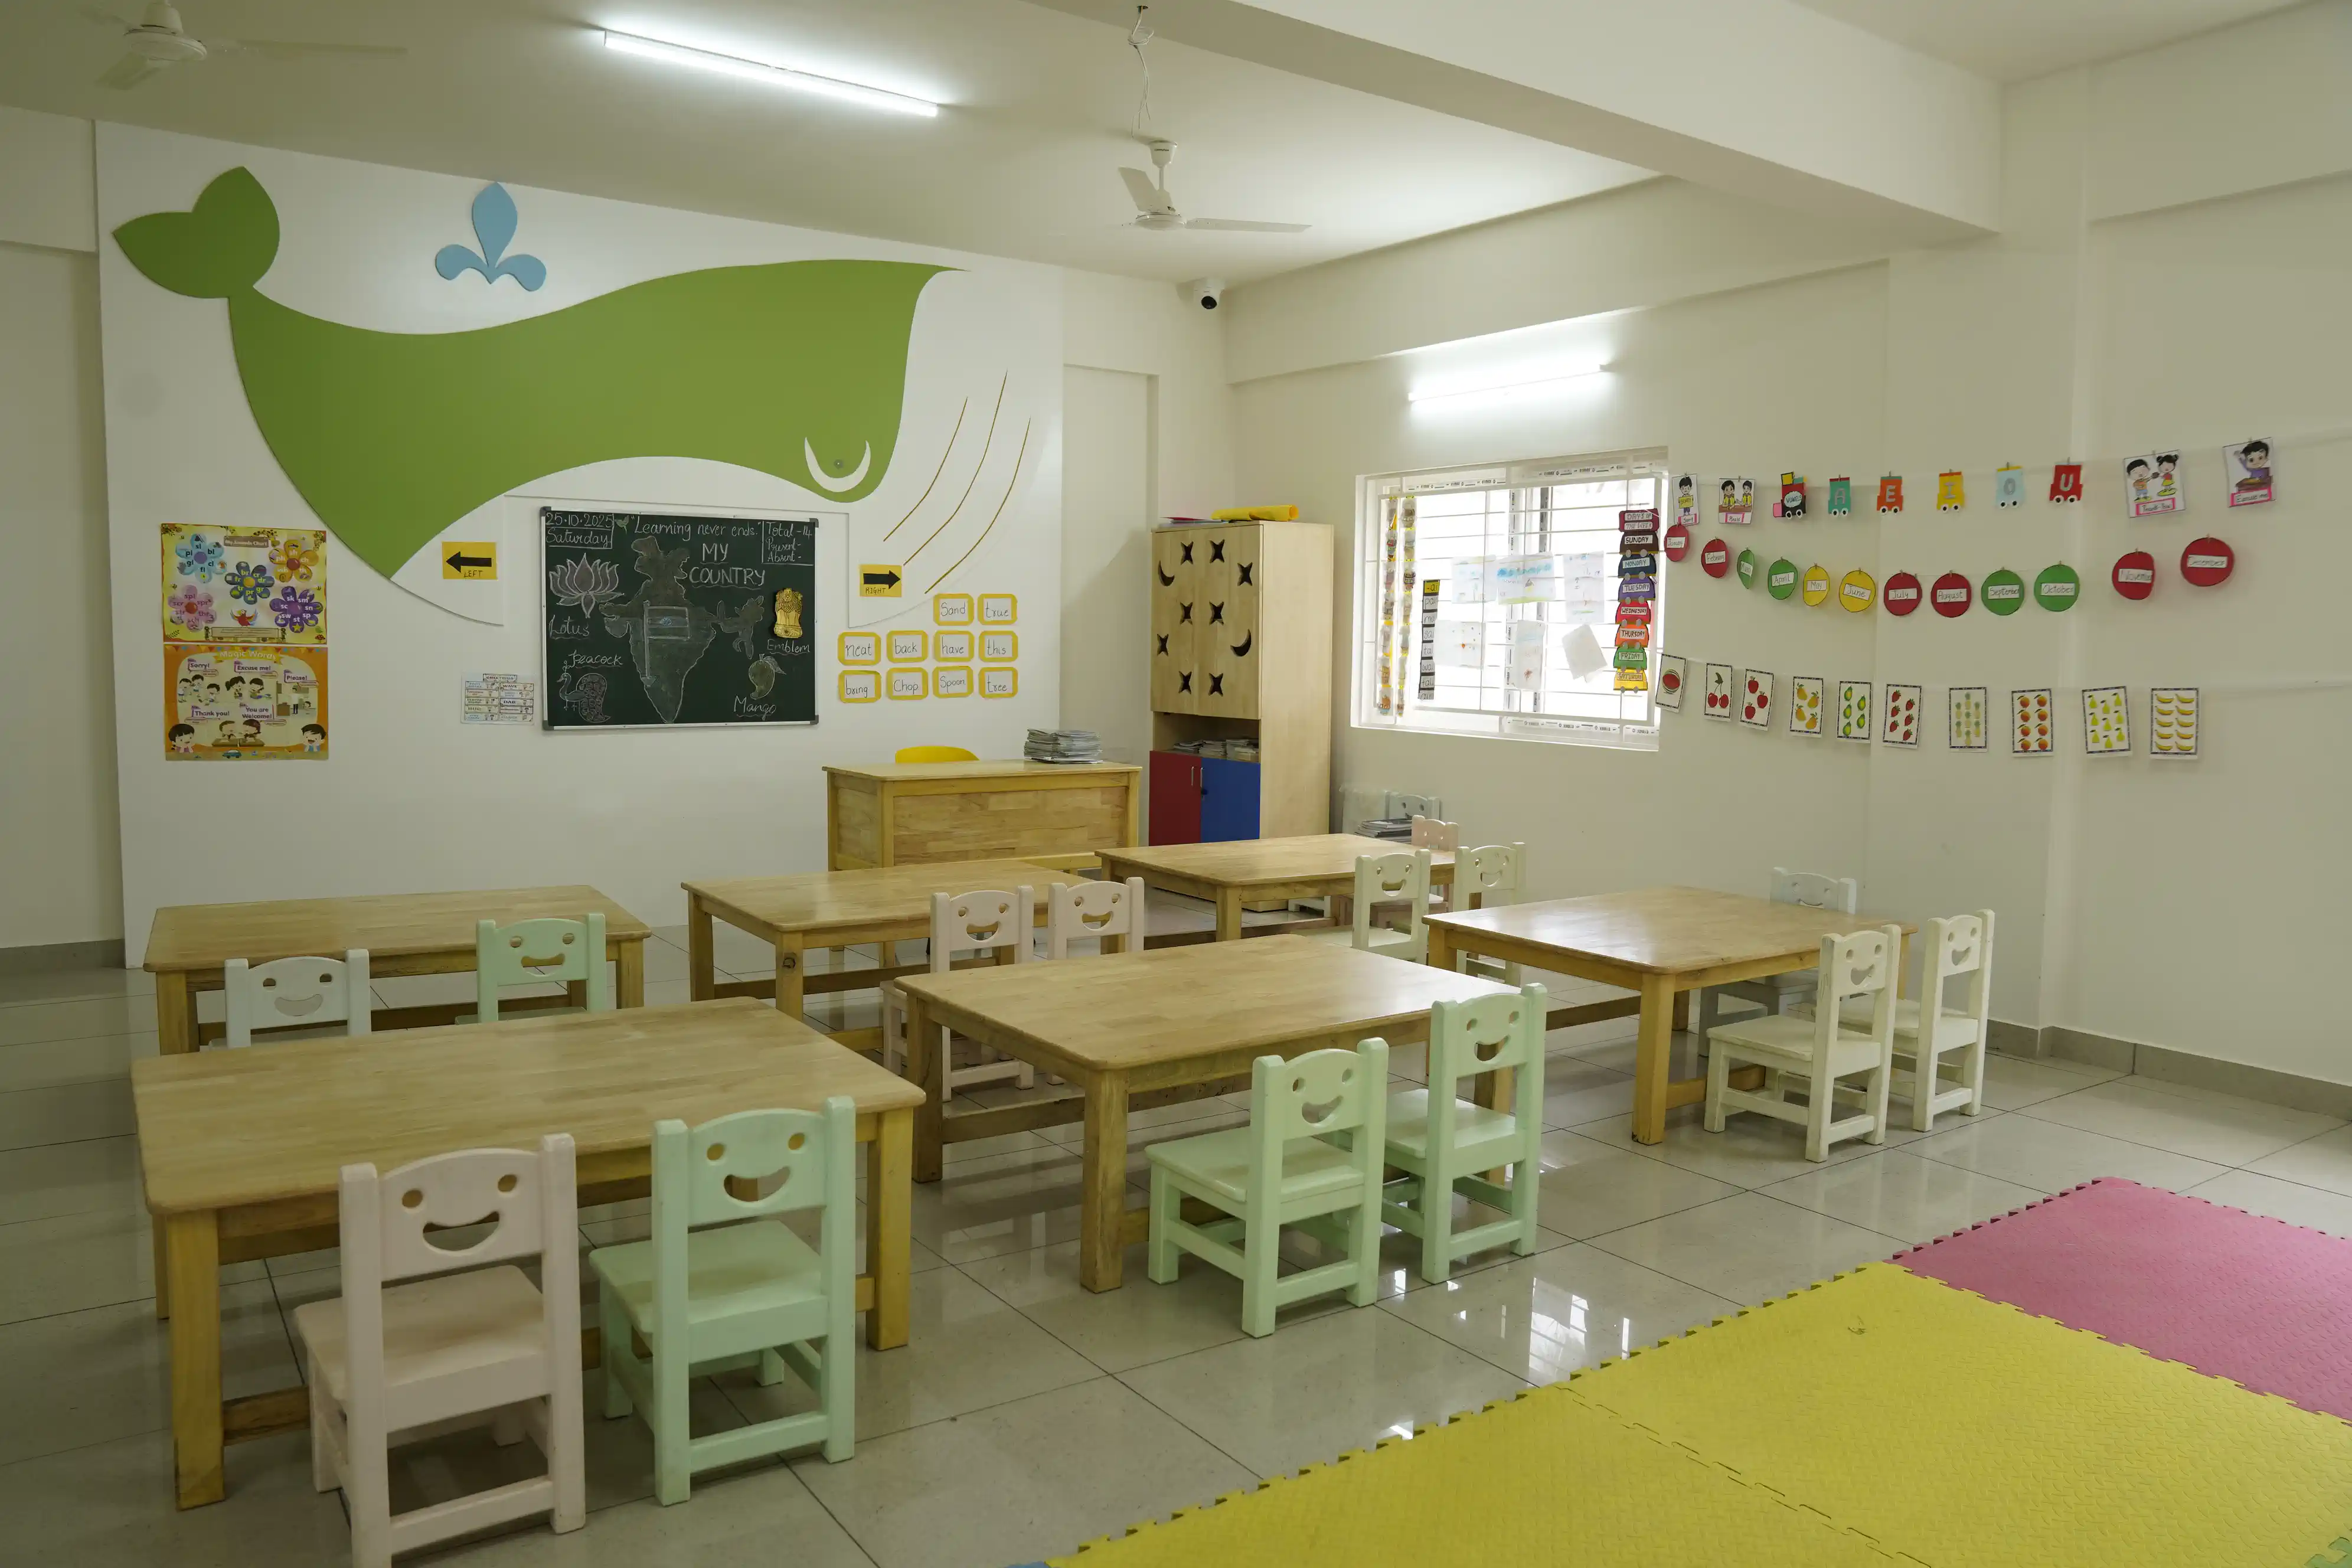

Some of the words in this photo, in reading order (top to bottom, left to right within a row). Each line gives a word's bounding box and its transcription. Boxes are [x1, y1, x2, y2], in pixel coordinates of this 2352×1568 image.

[1943, 481, 1957, 499] I
[2003, 478, 2016, 495] O
[2059, 473, 2074, 492] U
[1786, 495, 1802, 504] VOWELS
[1834, 488, 1846, 506] A
[1885, 485, 1896, 502] E
[545, 527, 611, 548] Saturday
[698, 524, 726, 536] never
[766, 522, 793, 538] Total
[703, 543, 729, 561] MY
[767, 551, 795, 562] Absent
[1625, 559, 1647, 567] MONDAY
[464, 570, 483, 578] LEFT
[688, 566, 766, 586] COUNTRY
[1773, 573, 1791, 584] April
[865, 587, 886, 595] RIGHT
[1811, 581, 1822, 591] May
[1847, 585, 1866, 597] June
[1892, 590, 1909, 599] July
[1938, 590, 1963, 602] August
[940, 602, 966, 617] Sand
[985, 602, 1009, 618] true
[548, 615, 590, 637] Lotus
[767, 639, 811, 653] Emblem
[845, 642, 873, 657] neat
[894, 638, 917, 655] back
[942, 635, 964, 655] have
[986, 639, 1007, 656] this
[220, 650, 246, 658] Magic
[249, 651, 276, 660] Words
[845, 677, 868, 698] bring
[986, 675, 1008, 693] tree
[734, 695, 777, 721] Mango
